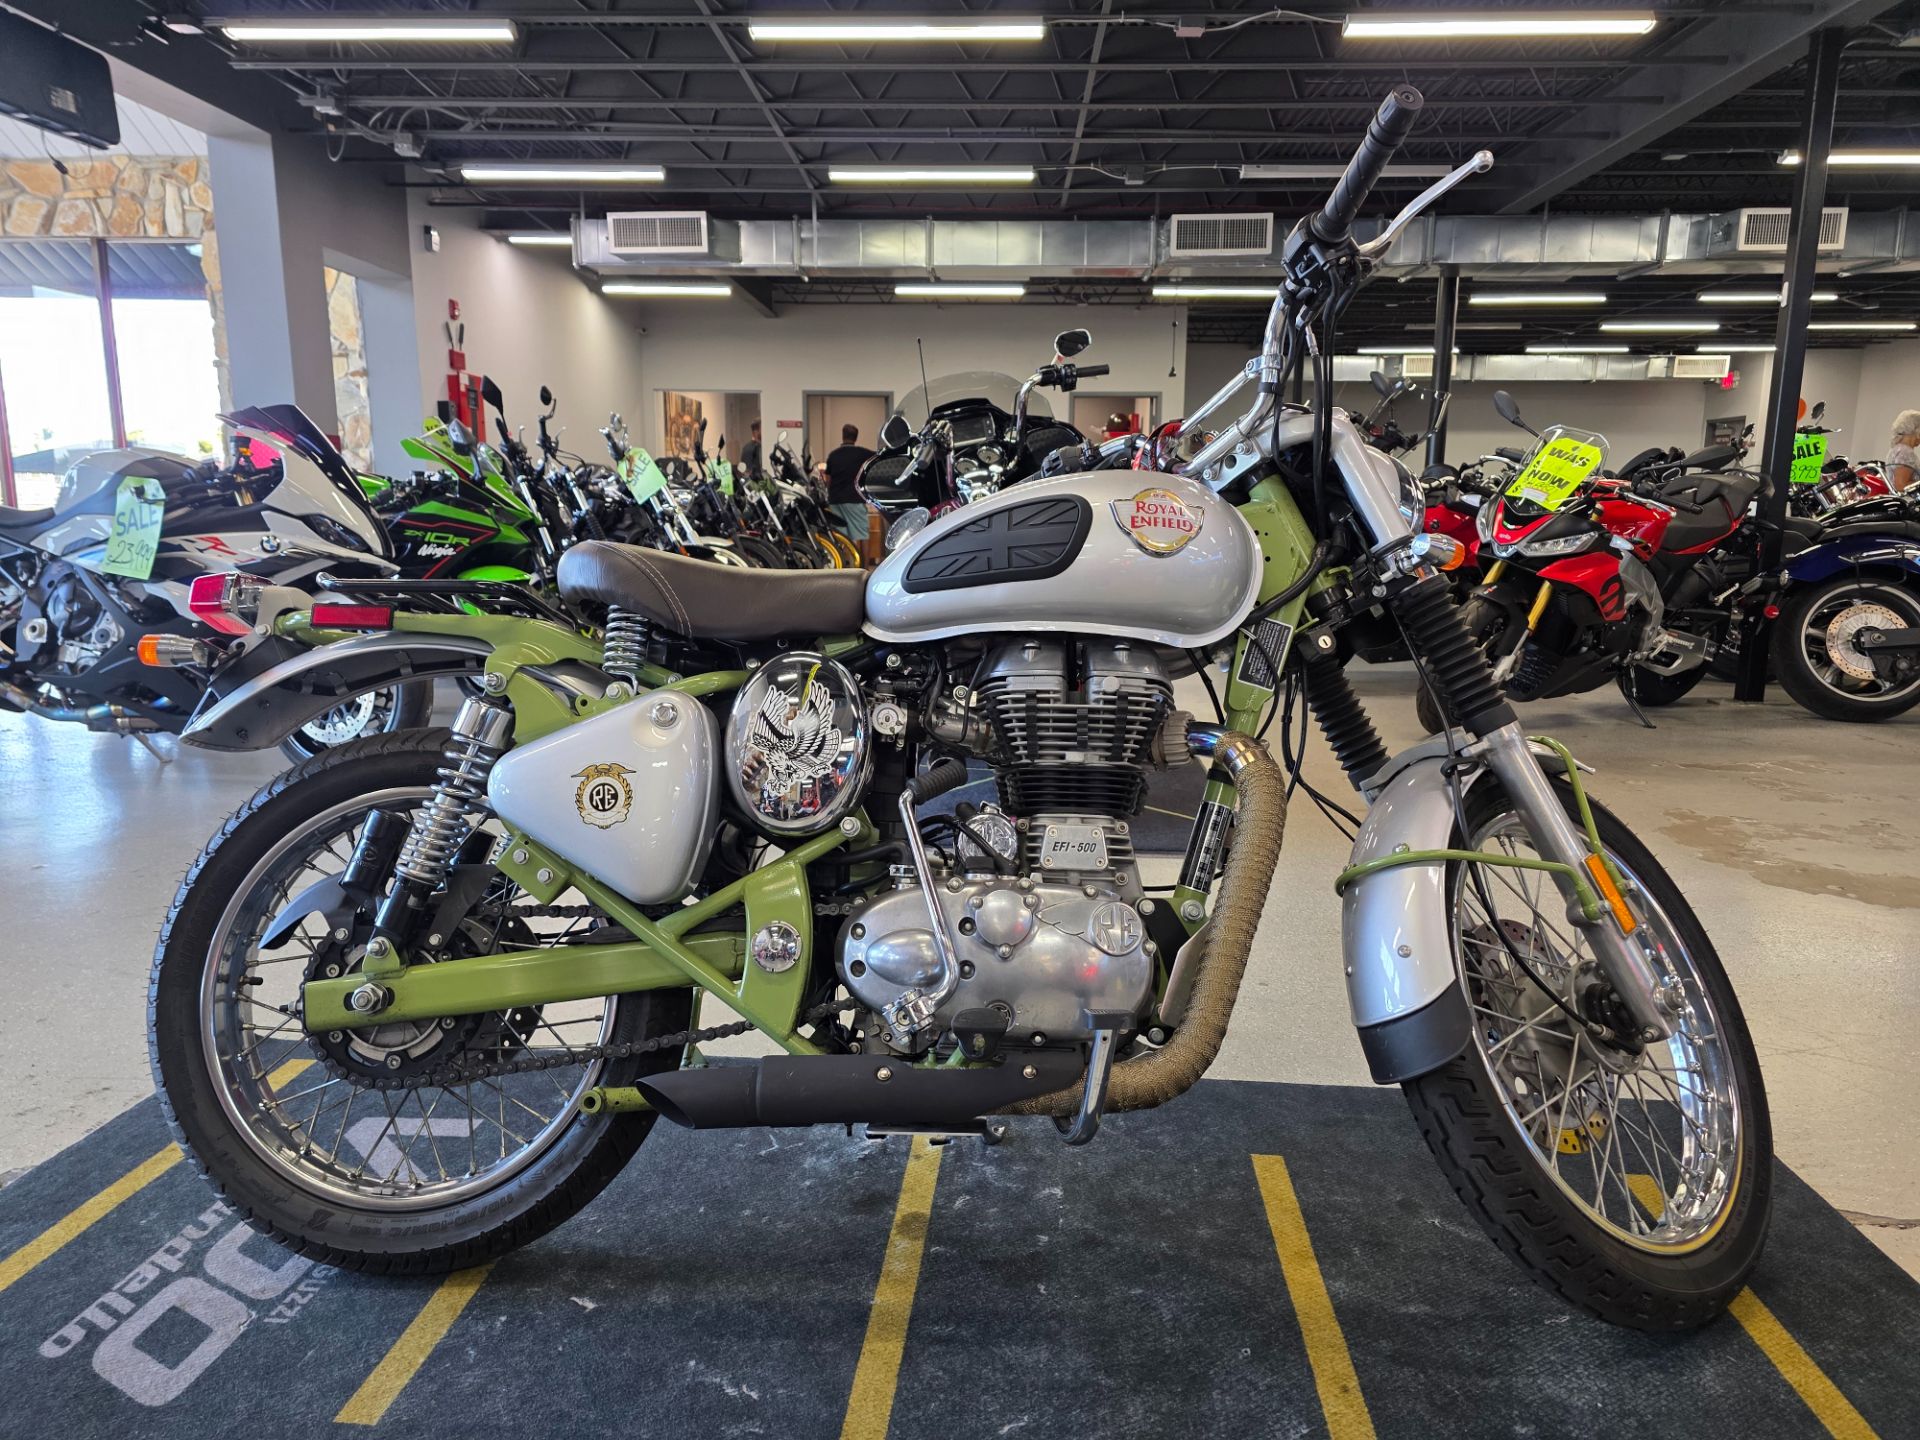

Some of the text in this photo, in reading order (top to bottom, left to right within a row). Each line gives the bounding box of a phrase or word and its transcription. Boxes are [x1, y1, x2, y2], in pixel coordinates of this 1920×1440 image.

[1548, 446, 1591, 468] WAS
[1527, 470, 1572, 490] NOW
[1135, 500, 1187, 516] ROYAL
[116, 503, 159, 536] SALE
[1130, 515, 1194, 532] ENFIELD
[417, 543, 457, 559] Ninja
[592, 784, 616, 810] RE
